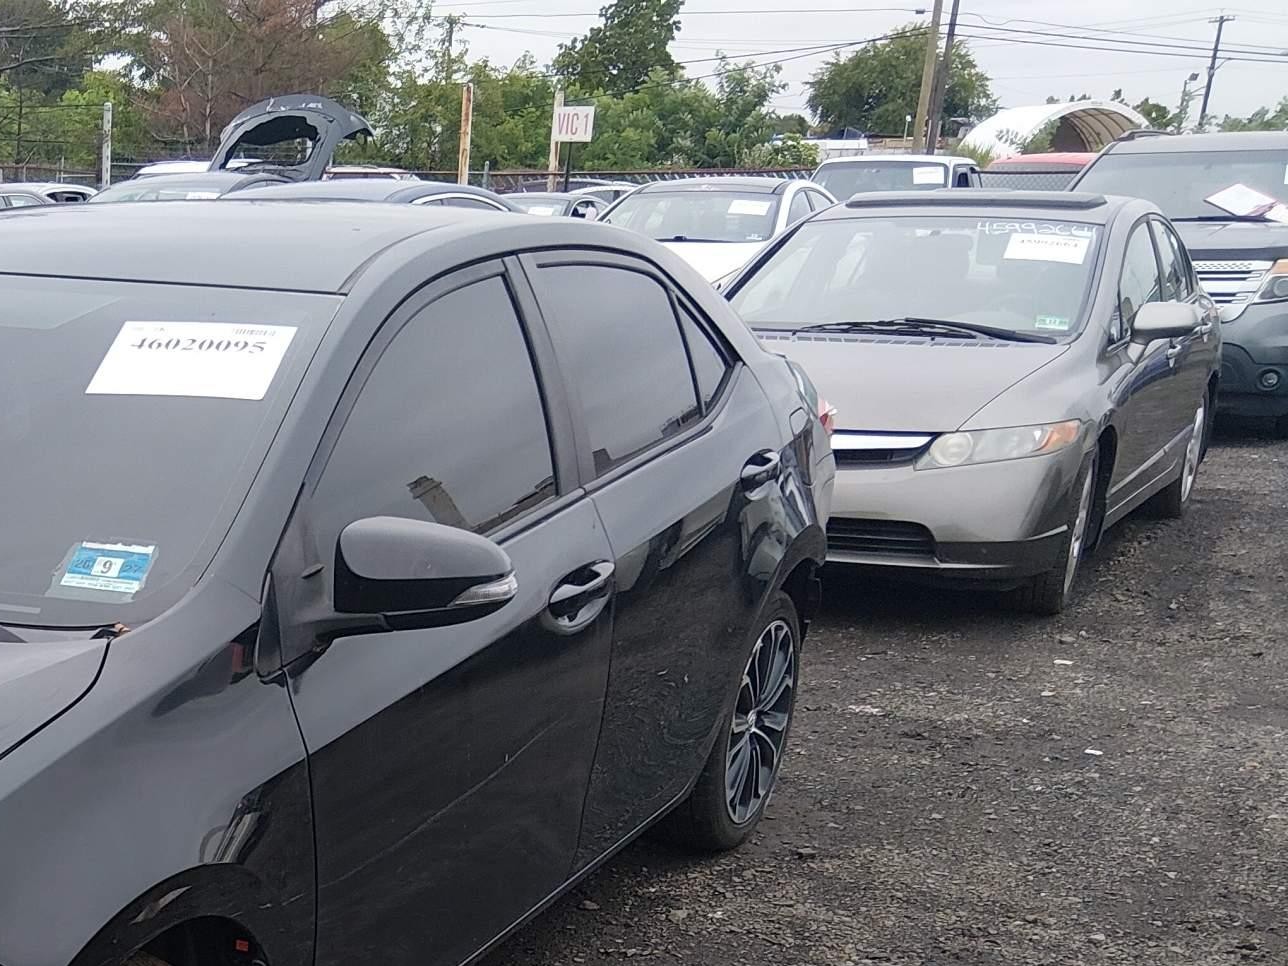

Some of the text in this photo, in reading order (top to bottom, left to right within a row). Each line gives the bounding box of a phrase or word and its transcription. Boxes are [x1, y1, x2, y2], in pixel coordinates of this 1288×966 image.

[557, 111, 590, 135] VIC 1
[130, 337, 267, 354] 46020095
[101, 559, 113, 574] 9
